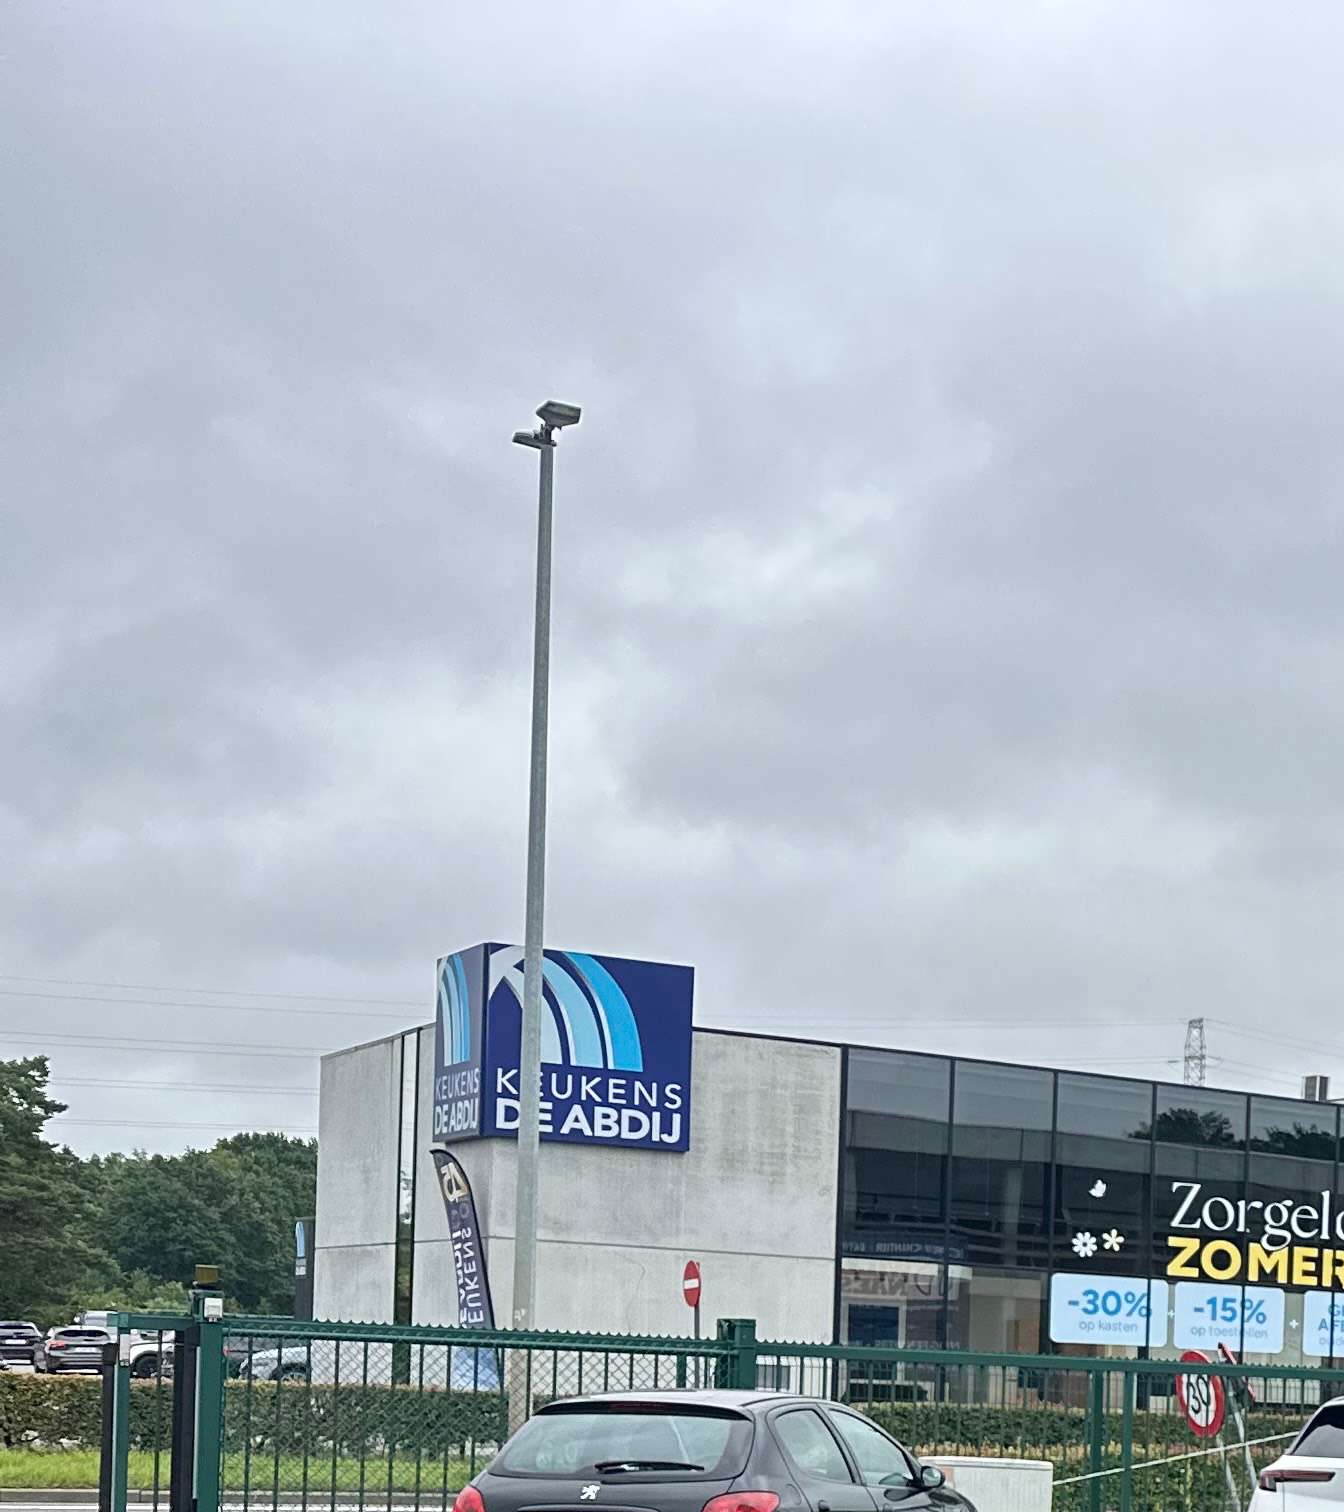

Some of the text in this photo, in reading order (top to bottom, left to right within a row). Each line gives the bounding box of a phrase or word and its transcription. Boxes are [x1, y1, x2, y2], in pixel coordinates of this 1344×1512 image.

[435, 1067, 479, 1101] KEUKENS
[434, 1097, 479, 1136] DE ABDIJ
[495, 1097, 682, 1144] DE ABDIJ
[1067, 1288, 1152, 1318] -30%
[1193, 1296, 1268, 1325] -15%
[1078, 1318, 1139, 1334] op kasten
[1186, 1371, 1210, 1414] 30
